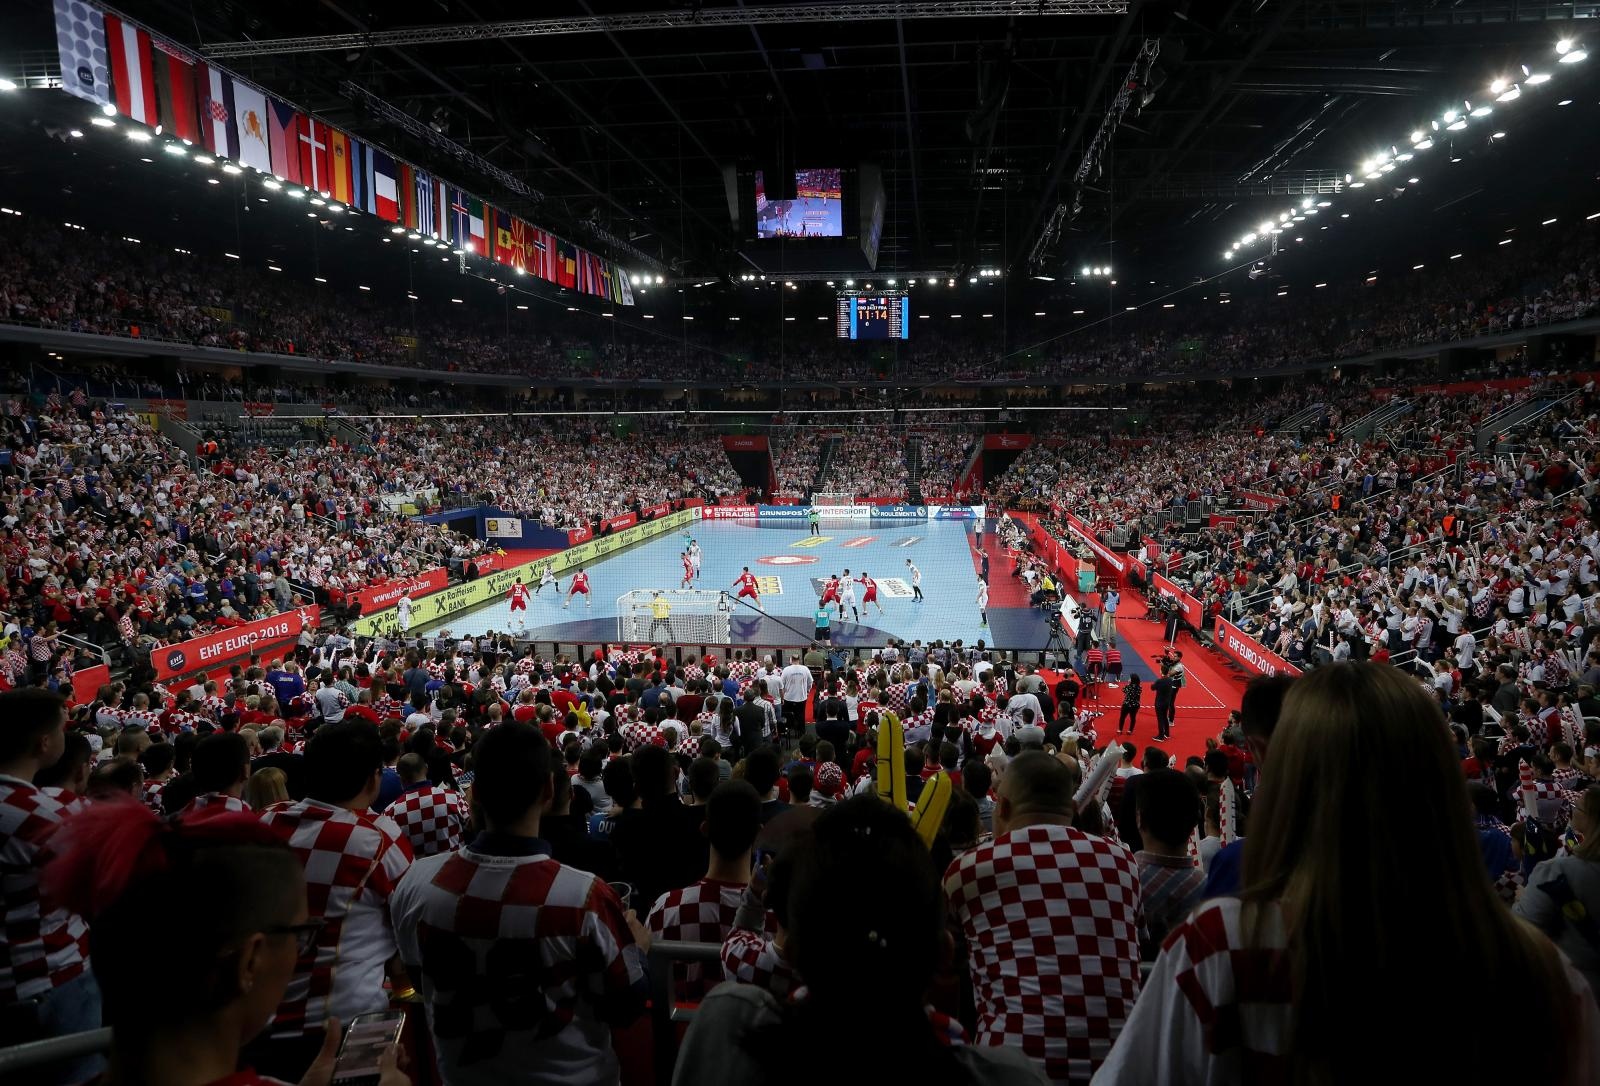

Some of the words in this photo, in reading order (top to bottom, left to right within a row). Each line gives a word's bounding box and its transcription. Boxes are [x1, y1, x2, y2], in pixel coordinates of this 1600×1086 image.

[859, 310, 887, 319] 11:14
[496, 569, 521, 582] Raiffeisen
[446, 585, 477, 601] Raiffeisen
[448, 597, 467, 612] BANK
[384, 604, 422, 623] Raien
[200, 643, 223, 659] EHF
[226, 632, 258, 651] EURO
[259, 622, 289, 639] 2018
[169, 654, 184, 665] EHF
[1228, 635, 1240, 653] EHF
[1239, 643, 1257, 665] EURO
[1256, 655, 1275, 678] 2018
